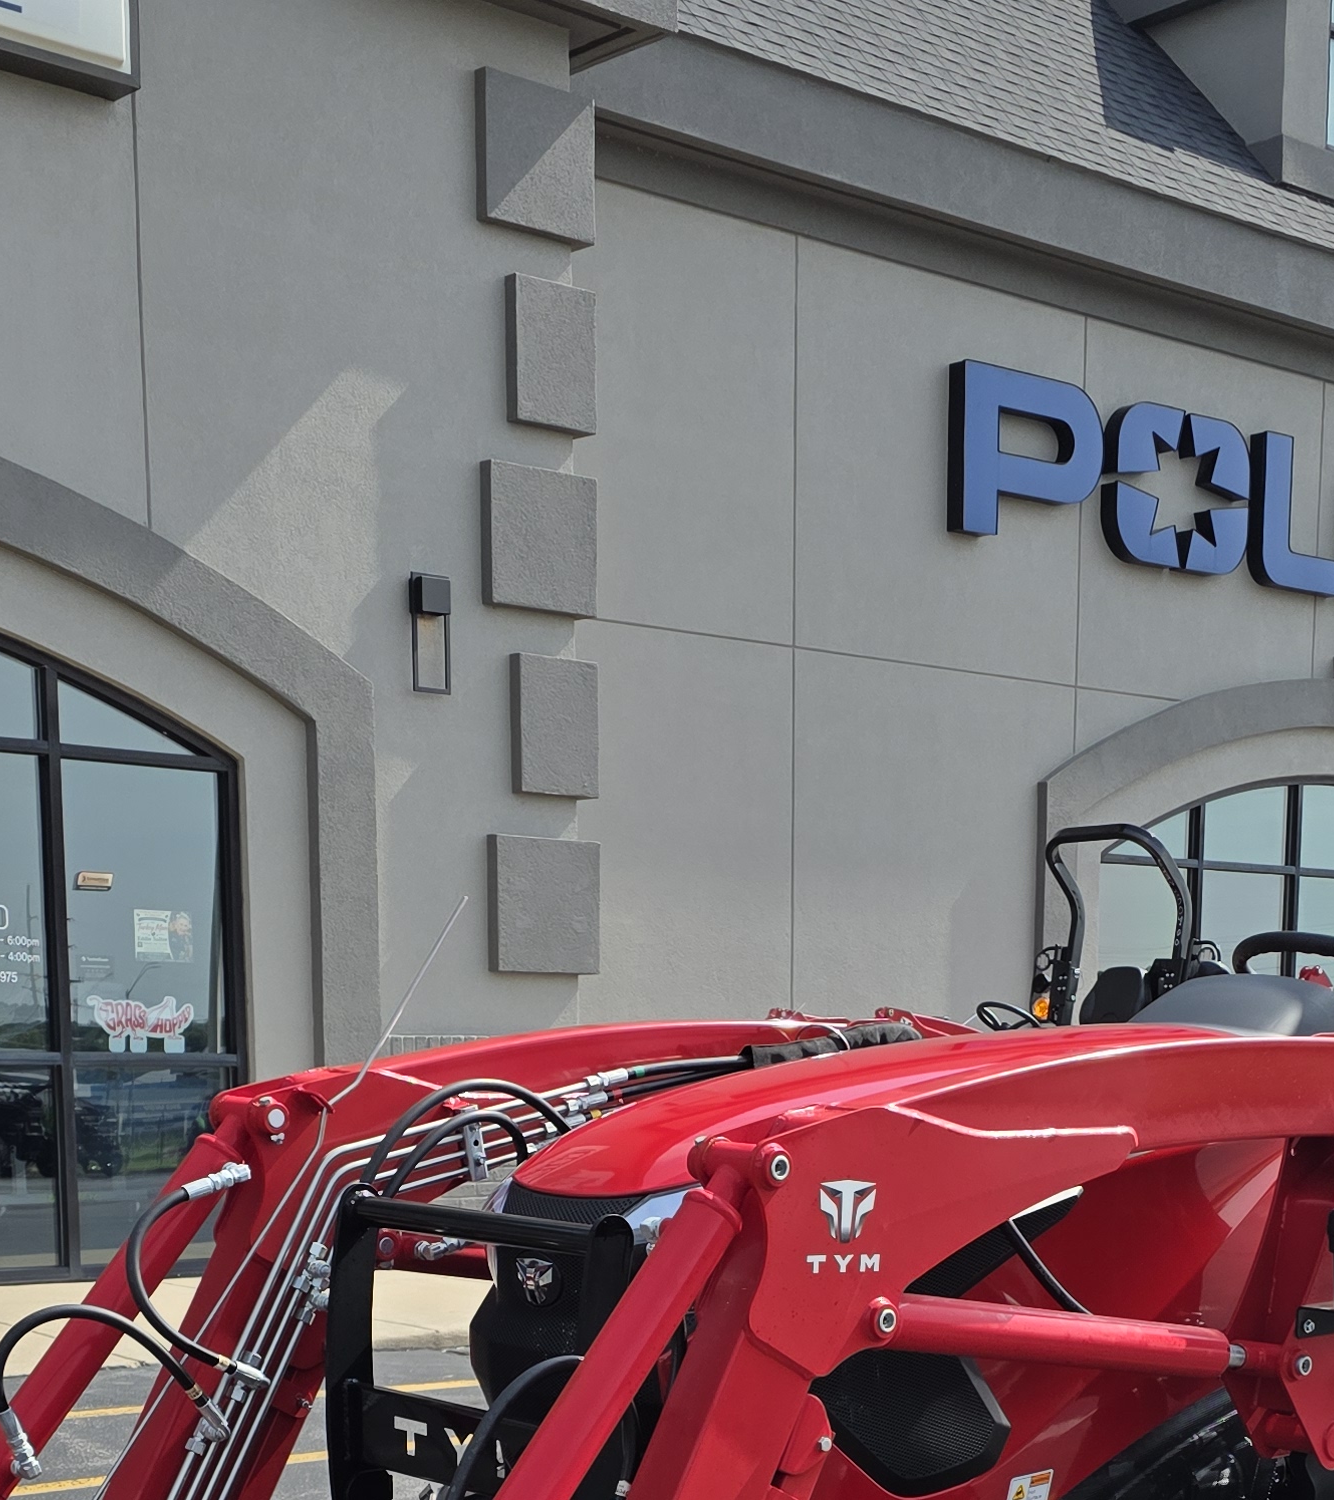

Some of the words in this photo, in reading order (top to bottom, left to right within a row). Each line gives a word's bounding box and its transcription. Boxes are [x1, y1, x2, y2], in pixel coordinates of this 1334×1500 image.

[7, 935, 40, 947] 6:00pm
[7, 951, 40, 964] 4:00pm
[806, 1253, 881, 1274] TYM
